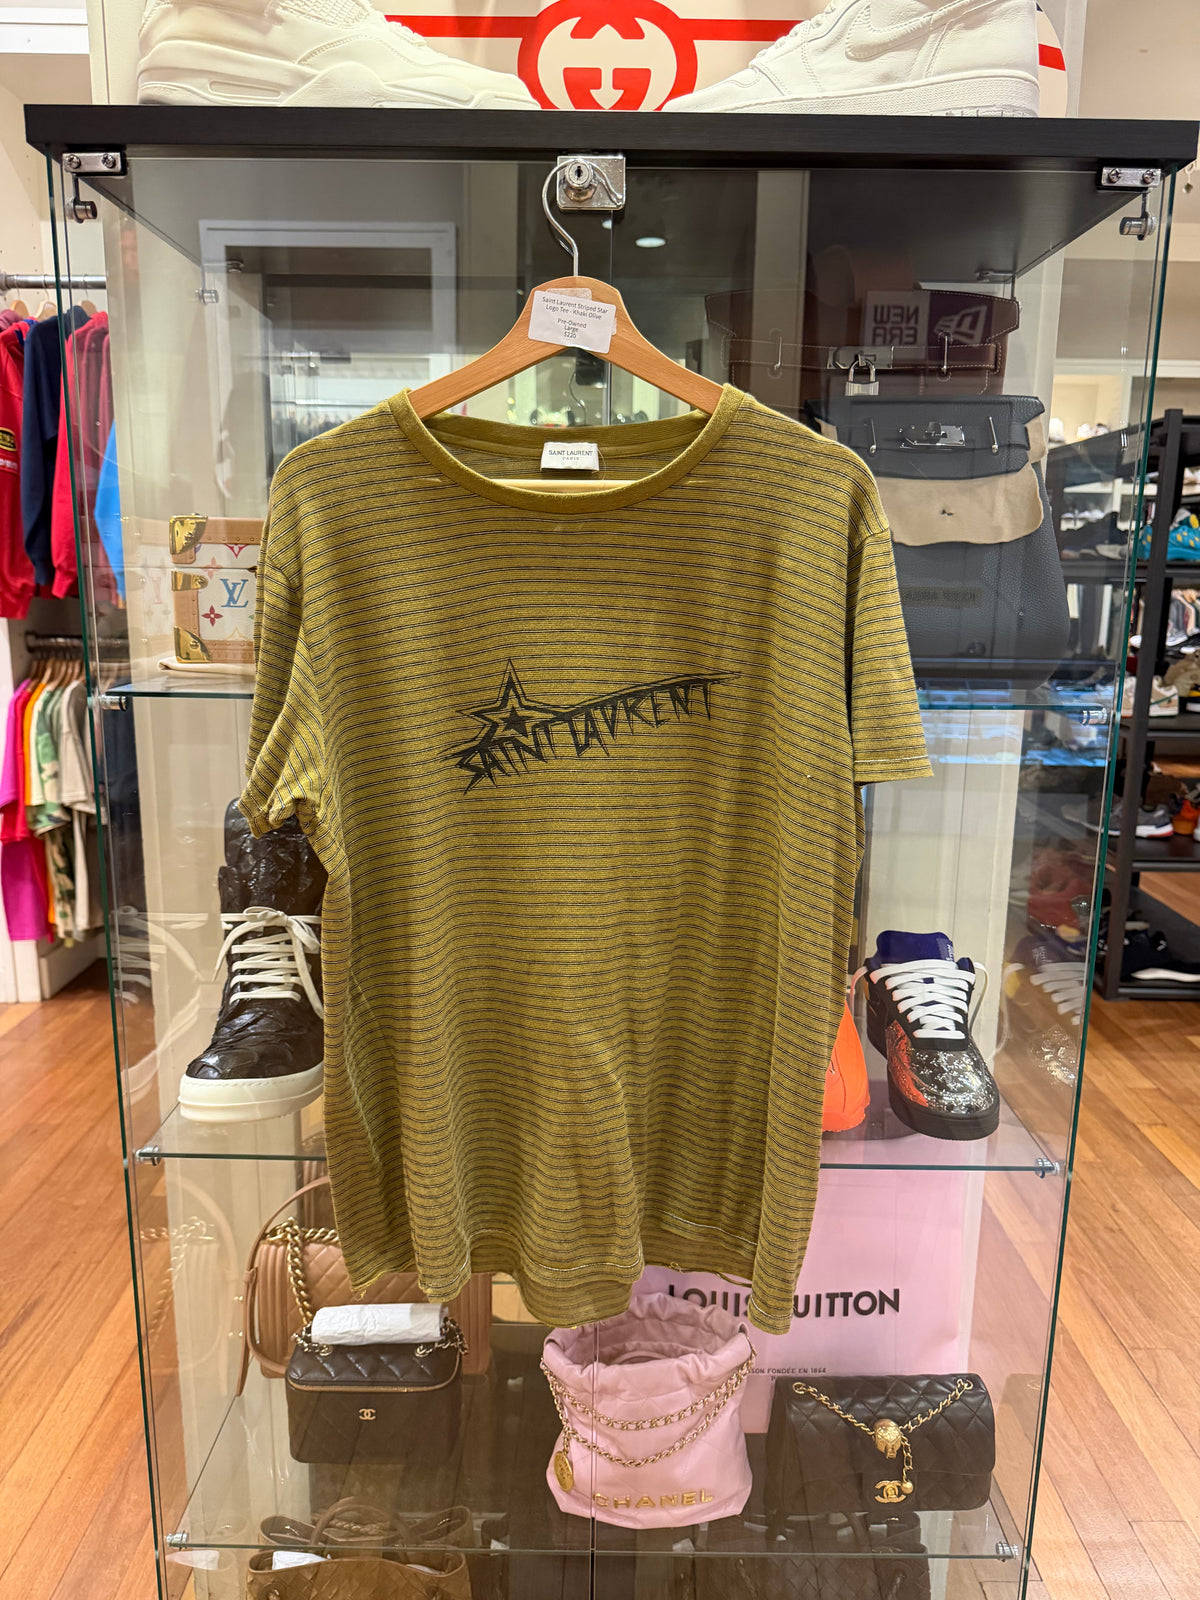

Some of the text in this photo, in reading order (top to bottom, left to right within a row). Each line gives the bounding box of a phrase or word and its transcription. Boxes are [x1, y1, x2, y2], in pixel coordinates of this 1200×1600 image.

[556, 299, 577, 308] Laurent
[577, 303, 597, 312] Striped
[557, 318, 587, 328] Pre-Owned
[793, 1288, 900, 1318] UITTON
[593, 1489, 714, 1509] CHANEL
